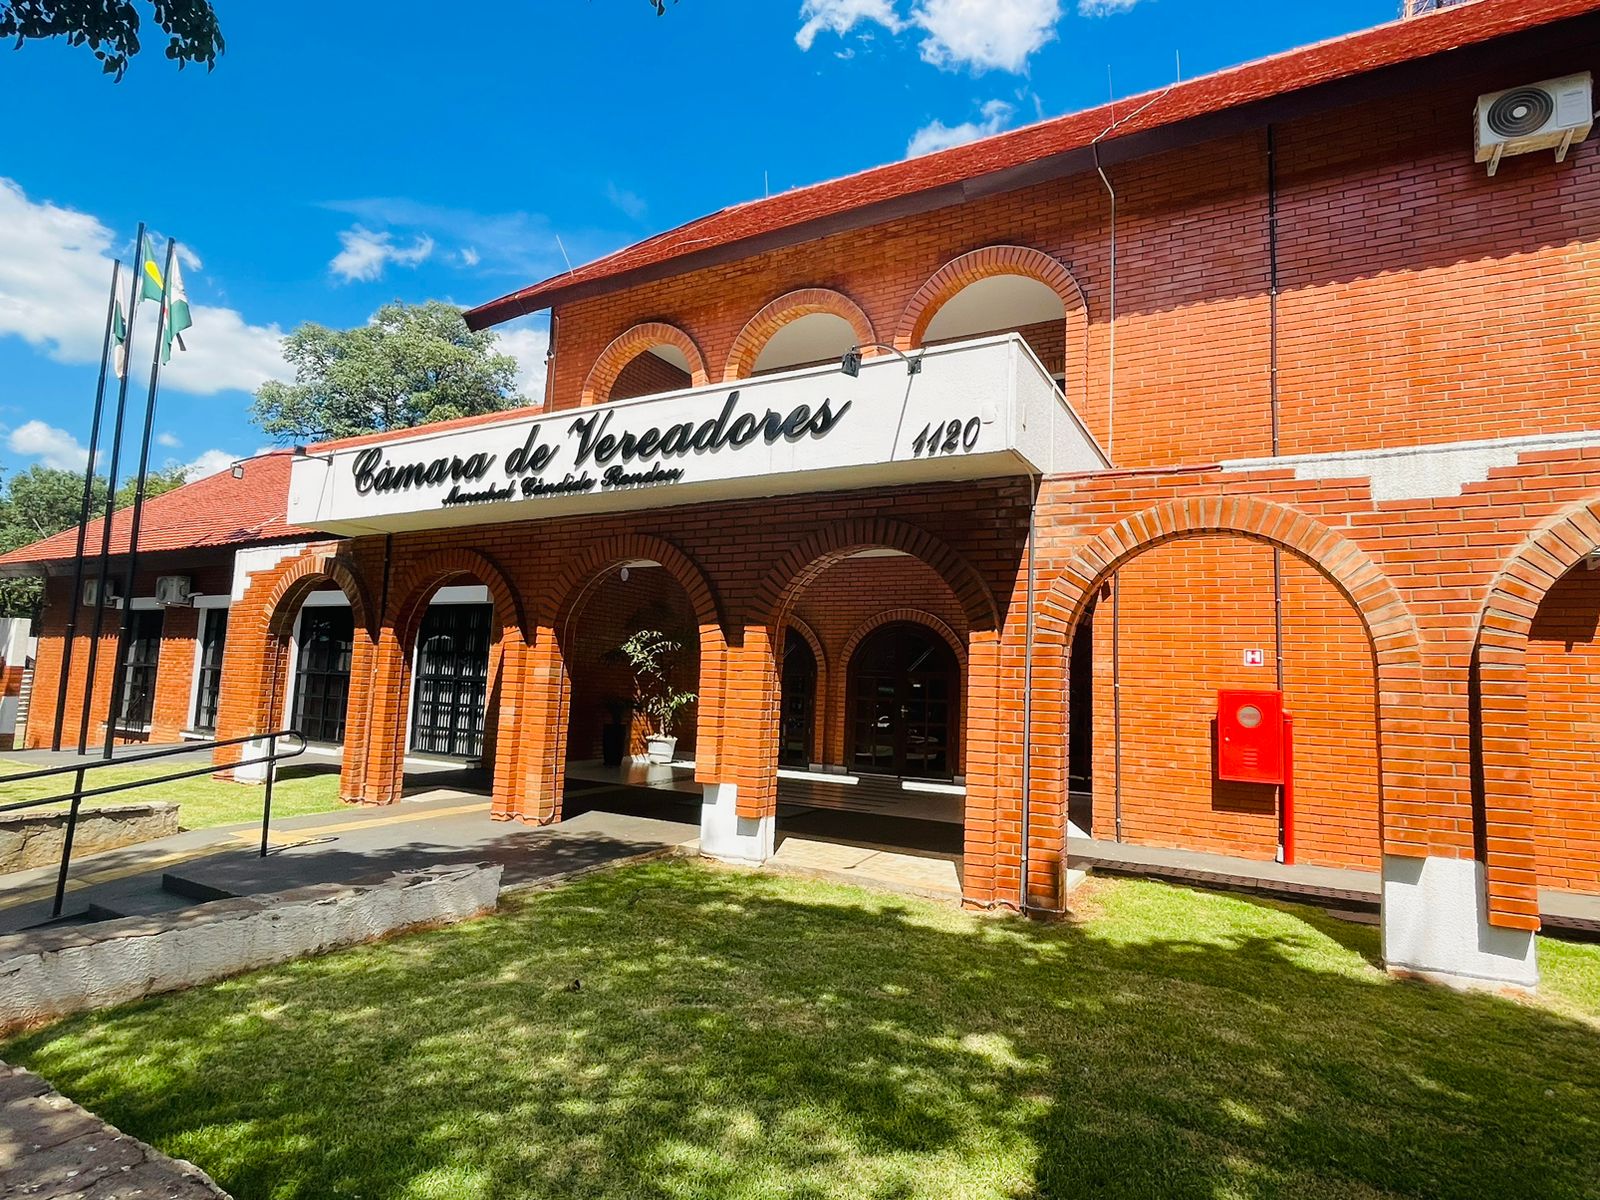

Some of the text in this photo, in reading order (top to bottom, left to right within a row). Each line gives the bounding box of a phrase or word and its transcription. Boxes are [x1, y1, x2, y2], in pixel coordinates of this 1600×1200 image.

[352, 390, 852, 494] Câmara de Vereadores
[912, 416, 981, 457] 1120
[601, 461, 684, 487] Rondon
[1247, 650, 1261, 664] H
